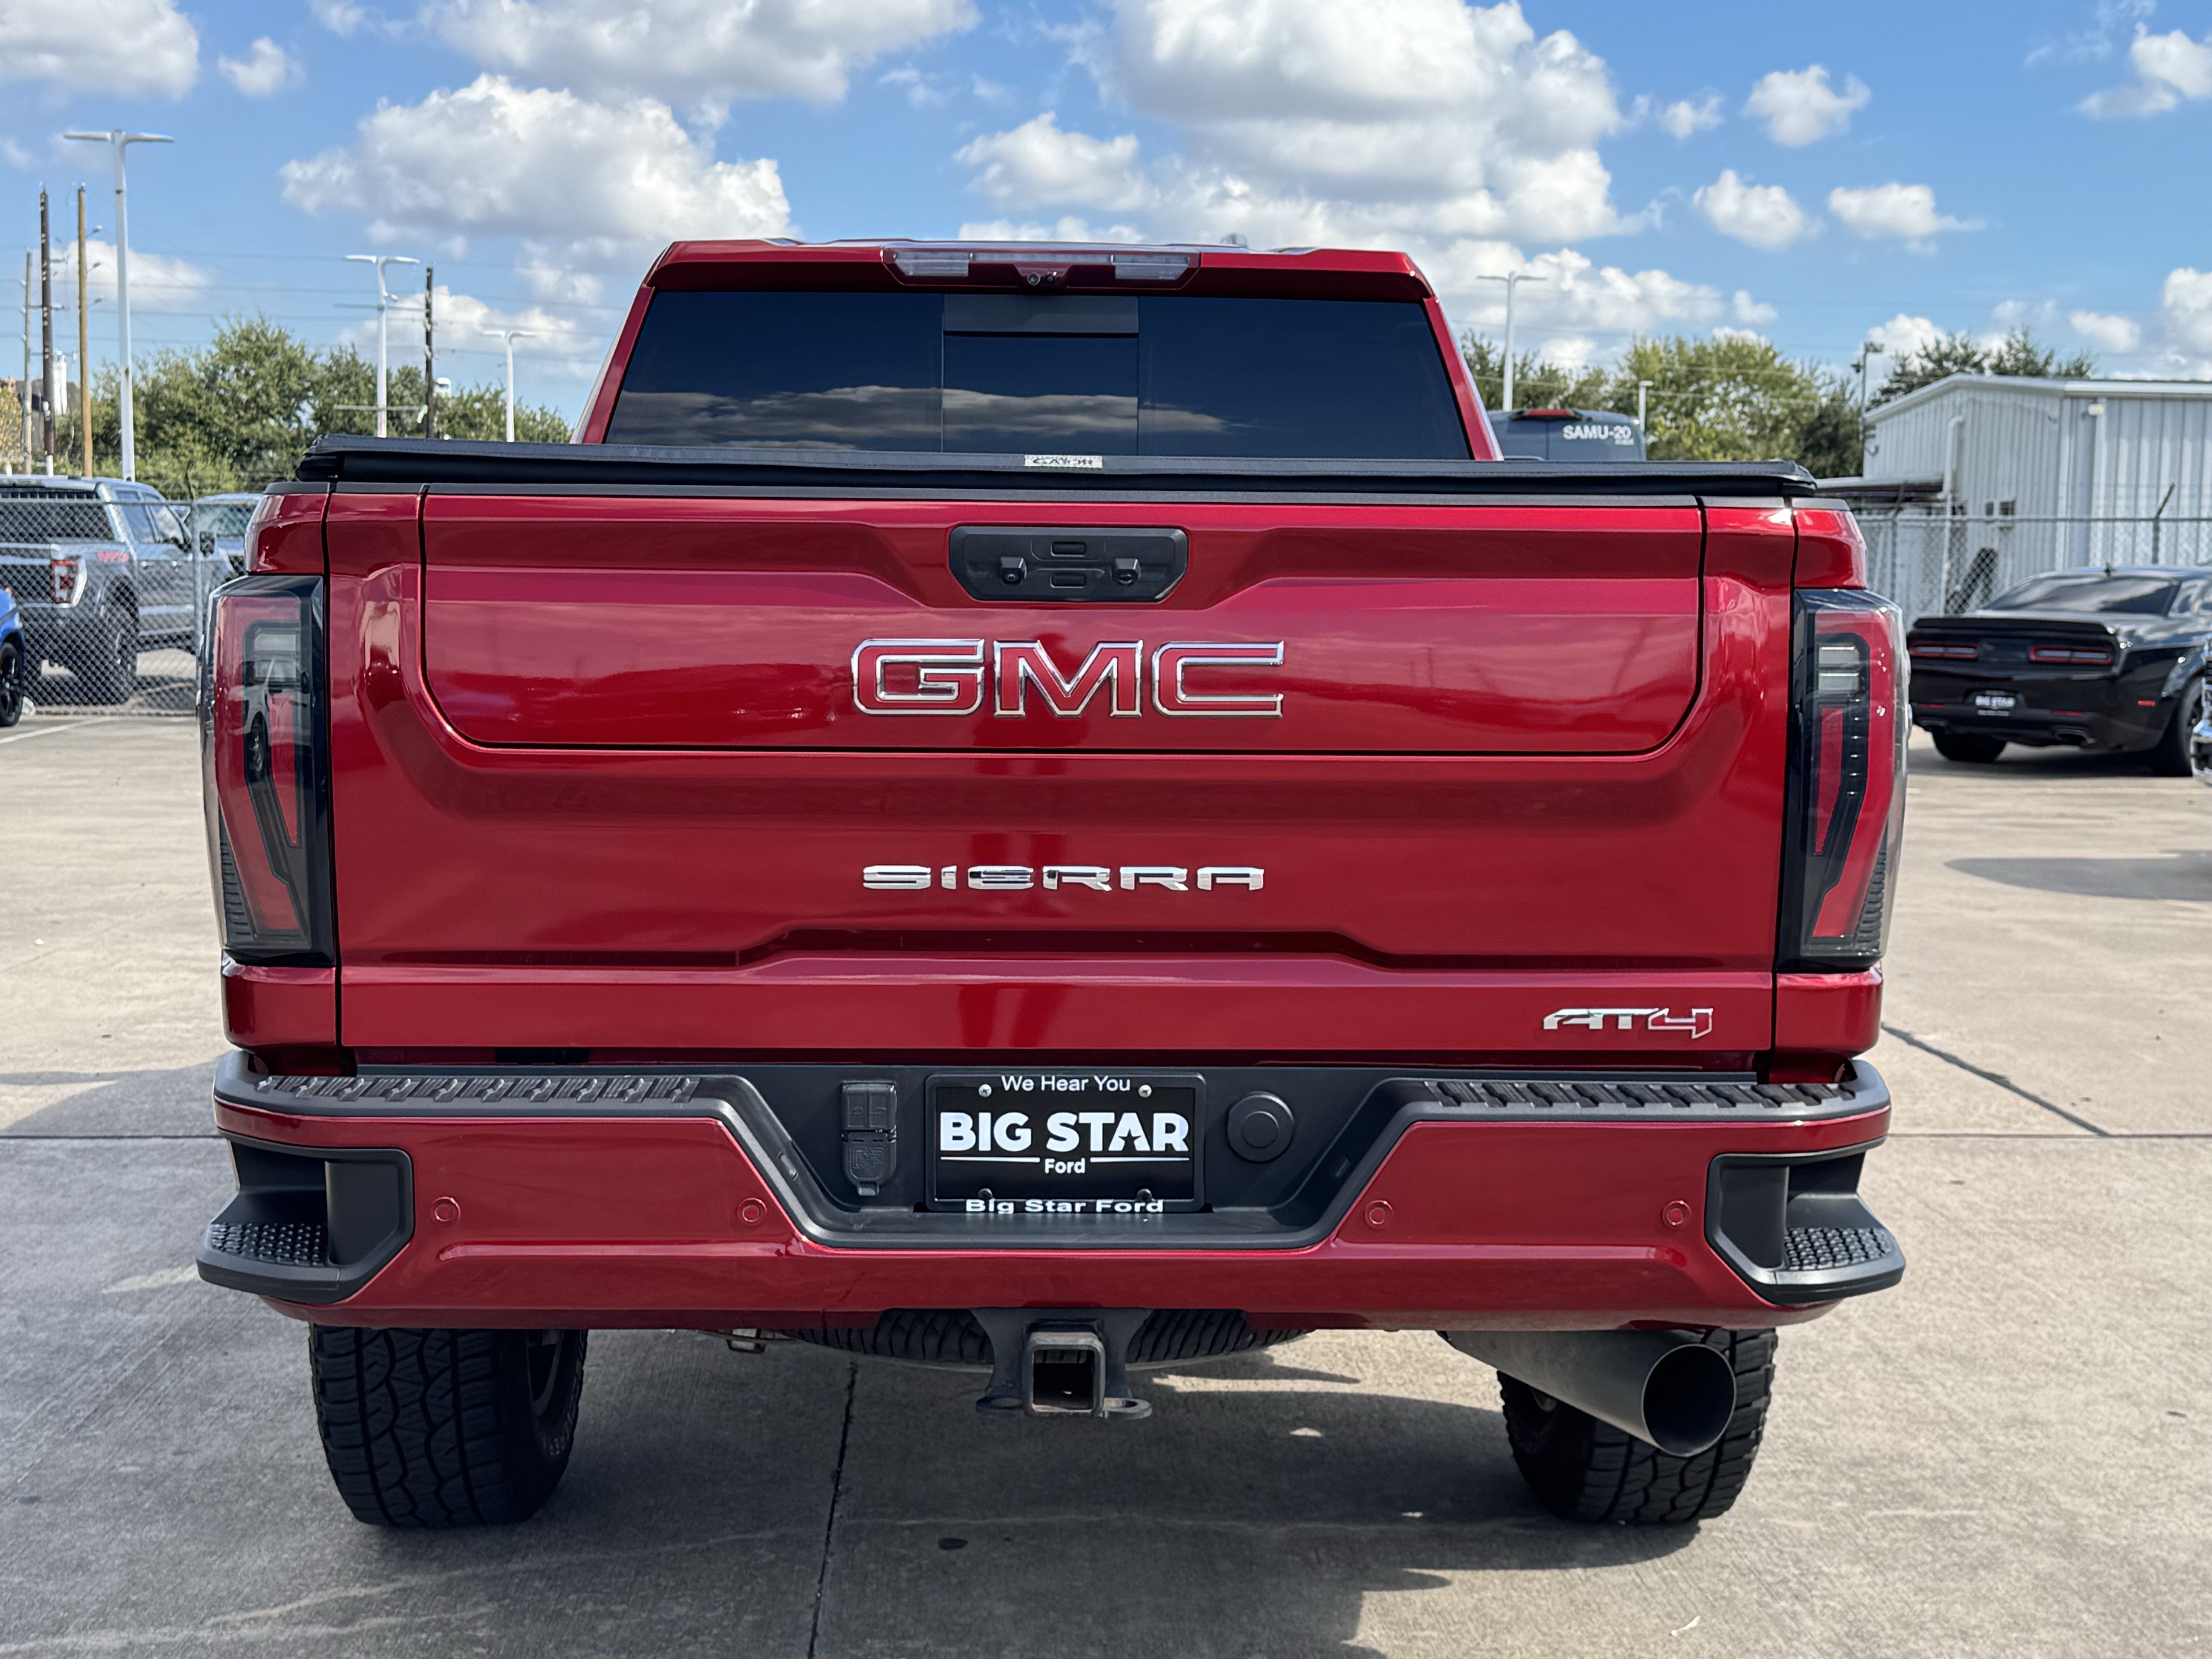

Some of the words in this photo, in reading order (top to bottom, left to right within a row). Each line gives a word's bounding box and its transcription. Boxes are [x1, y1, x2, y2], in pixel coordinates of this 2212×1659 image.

[1563, 425, 1632, 440] SAMU-20
[850, 638, 1284, 718] GMC
[863, 865, 1264, 891] SIERRA
[1543, 1008, 1714, 1039] AT4
[1001, 1075, 1034, 1091] We
[1041, 1075, 1089, 1091] Hear
[1094, 1075, 1130, 1091] You
[940, 1112, 1032, 1152] BIG
[1046, 1112, 1188, 1152] STAR
[1045, 1158, 1085, 1174] Ford
[966, 1199, 1014, 1213] Big
[1025, 1199, 1086, 1212] Star
[1096, 1199, 1163, 1212] Ford
